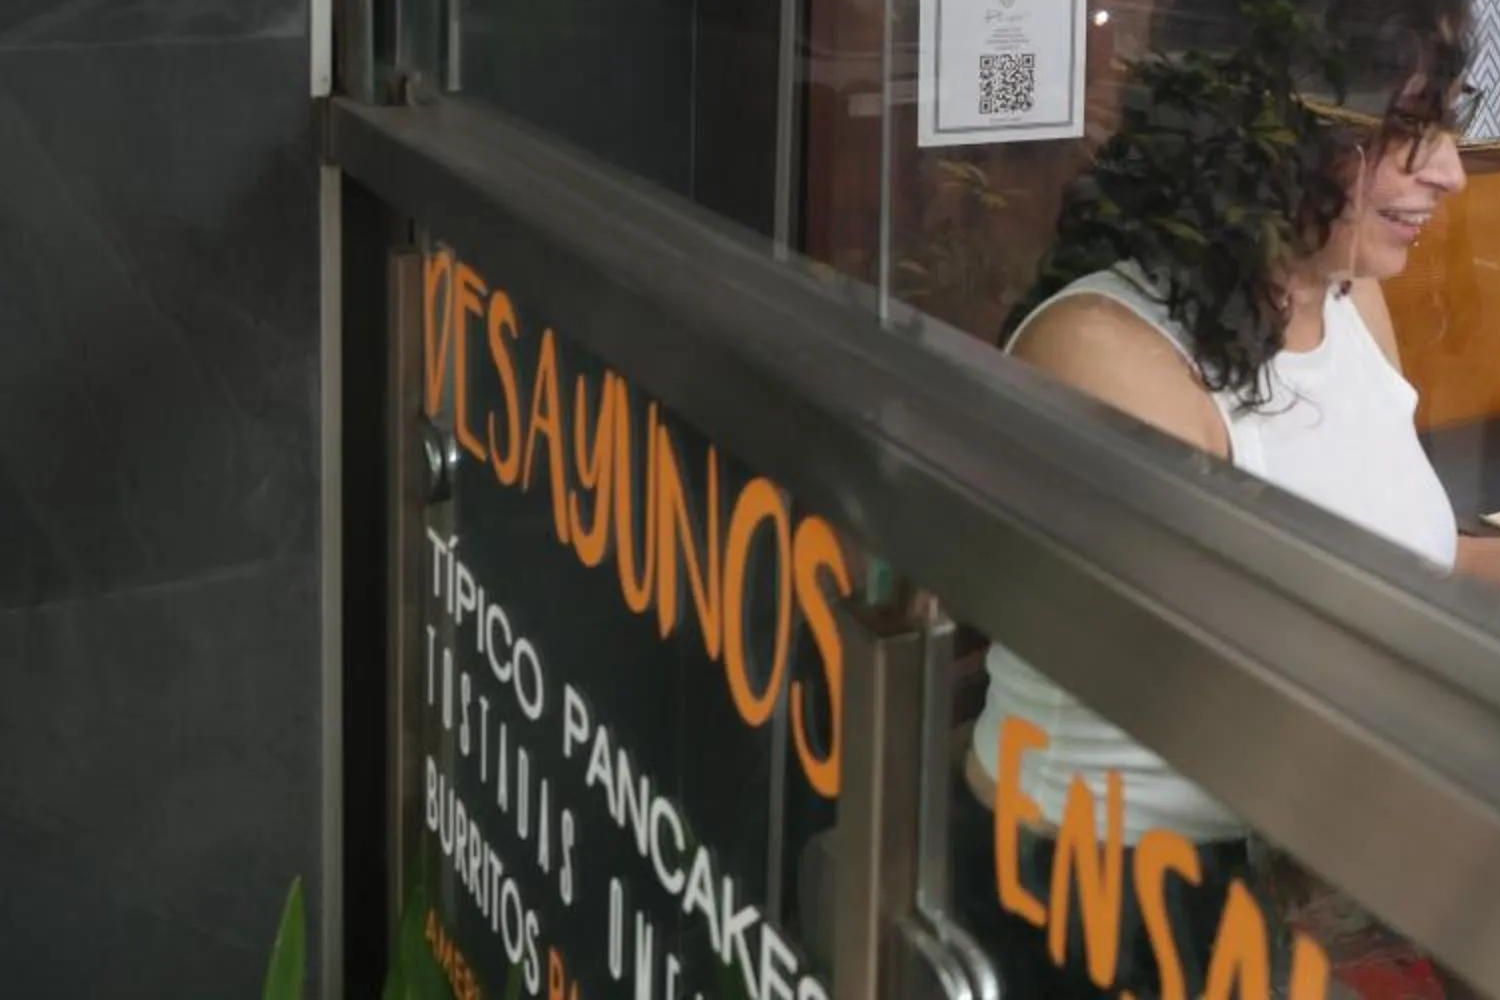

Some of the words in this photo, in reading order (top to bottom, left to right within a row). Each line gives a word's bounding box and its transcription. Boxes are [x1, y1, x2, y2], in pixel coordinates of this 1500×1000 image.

[423, 242, 852, 798] DESAYUNOS
[426, 526, 544, 720] TÍPICO
[425, 624, 575, 906] TOSTADAS
[426, 755, 541, 996] BURRITOS
